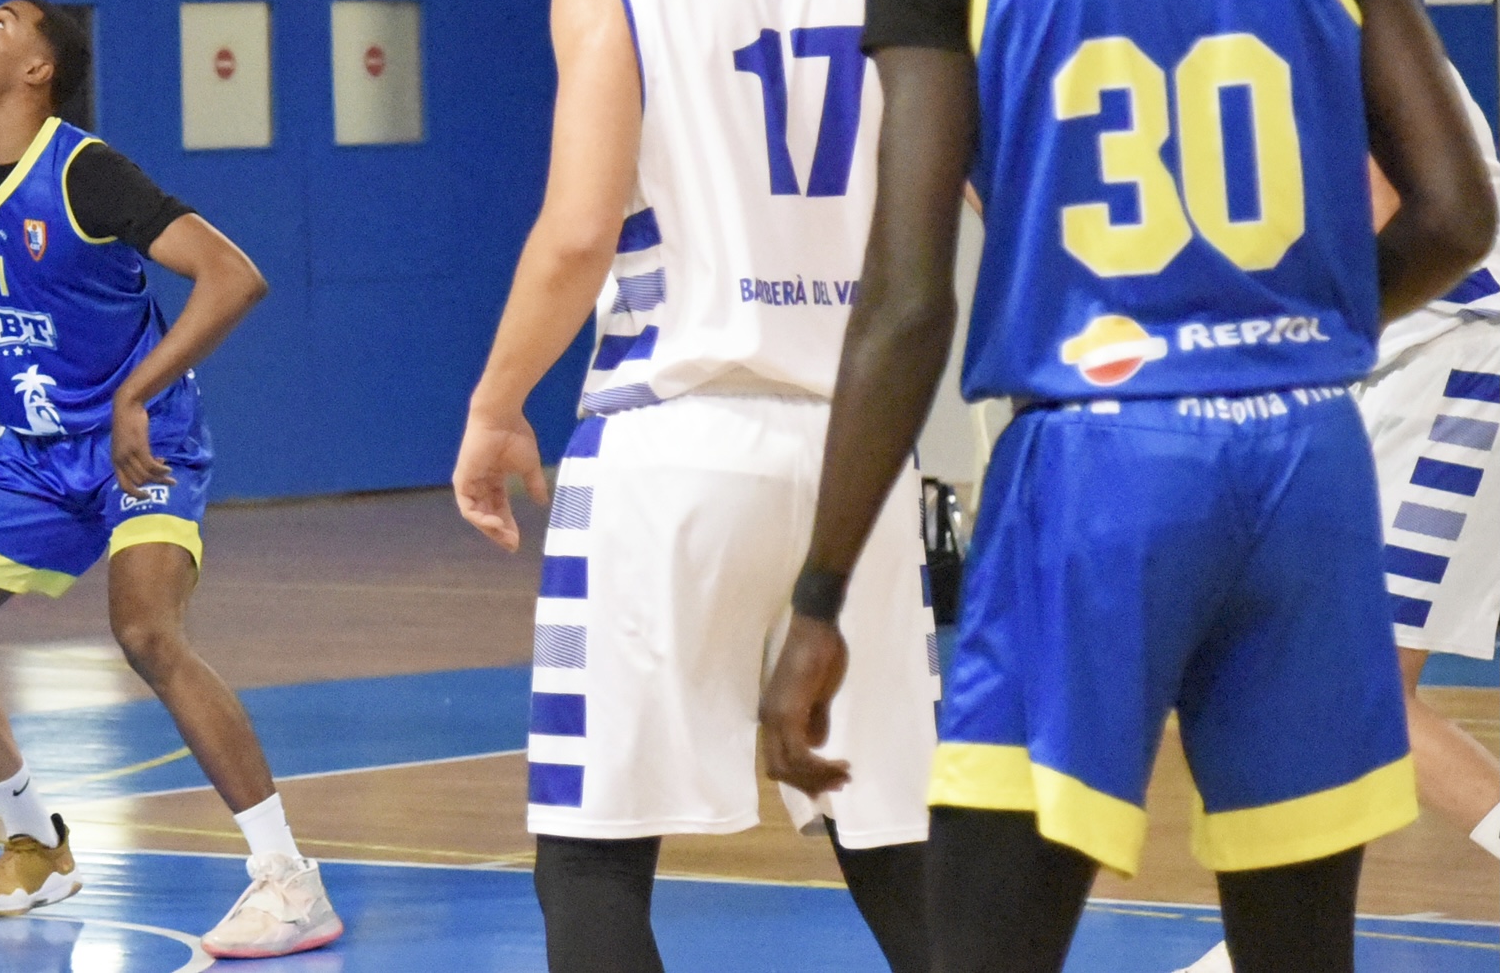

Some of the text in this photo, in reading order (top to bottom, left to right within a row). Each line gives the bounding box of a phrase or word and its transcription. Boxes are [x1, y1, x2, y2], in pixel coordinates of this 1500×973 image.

[732, 25, 868, 197] 17
[1052, 32, 1306, 278] 30
[739, 274, 807, 306] BARBERÀ
[812, 280, 833, 306] DEL
